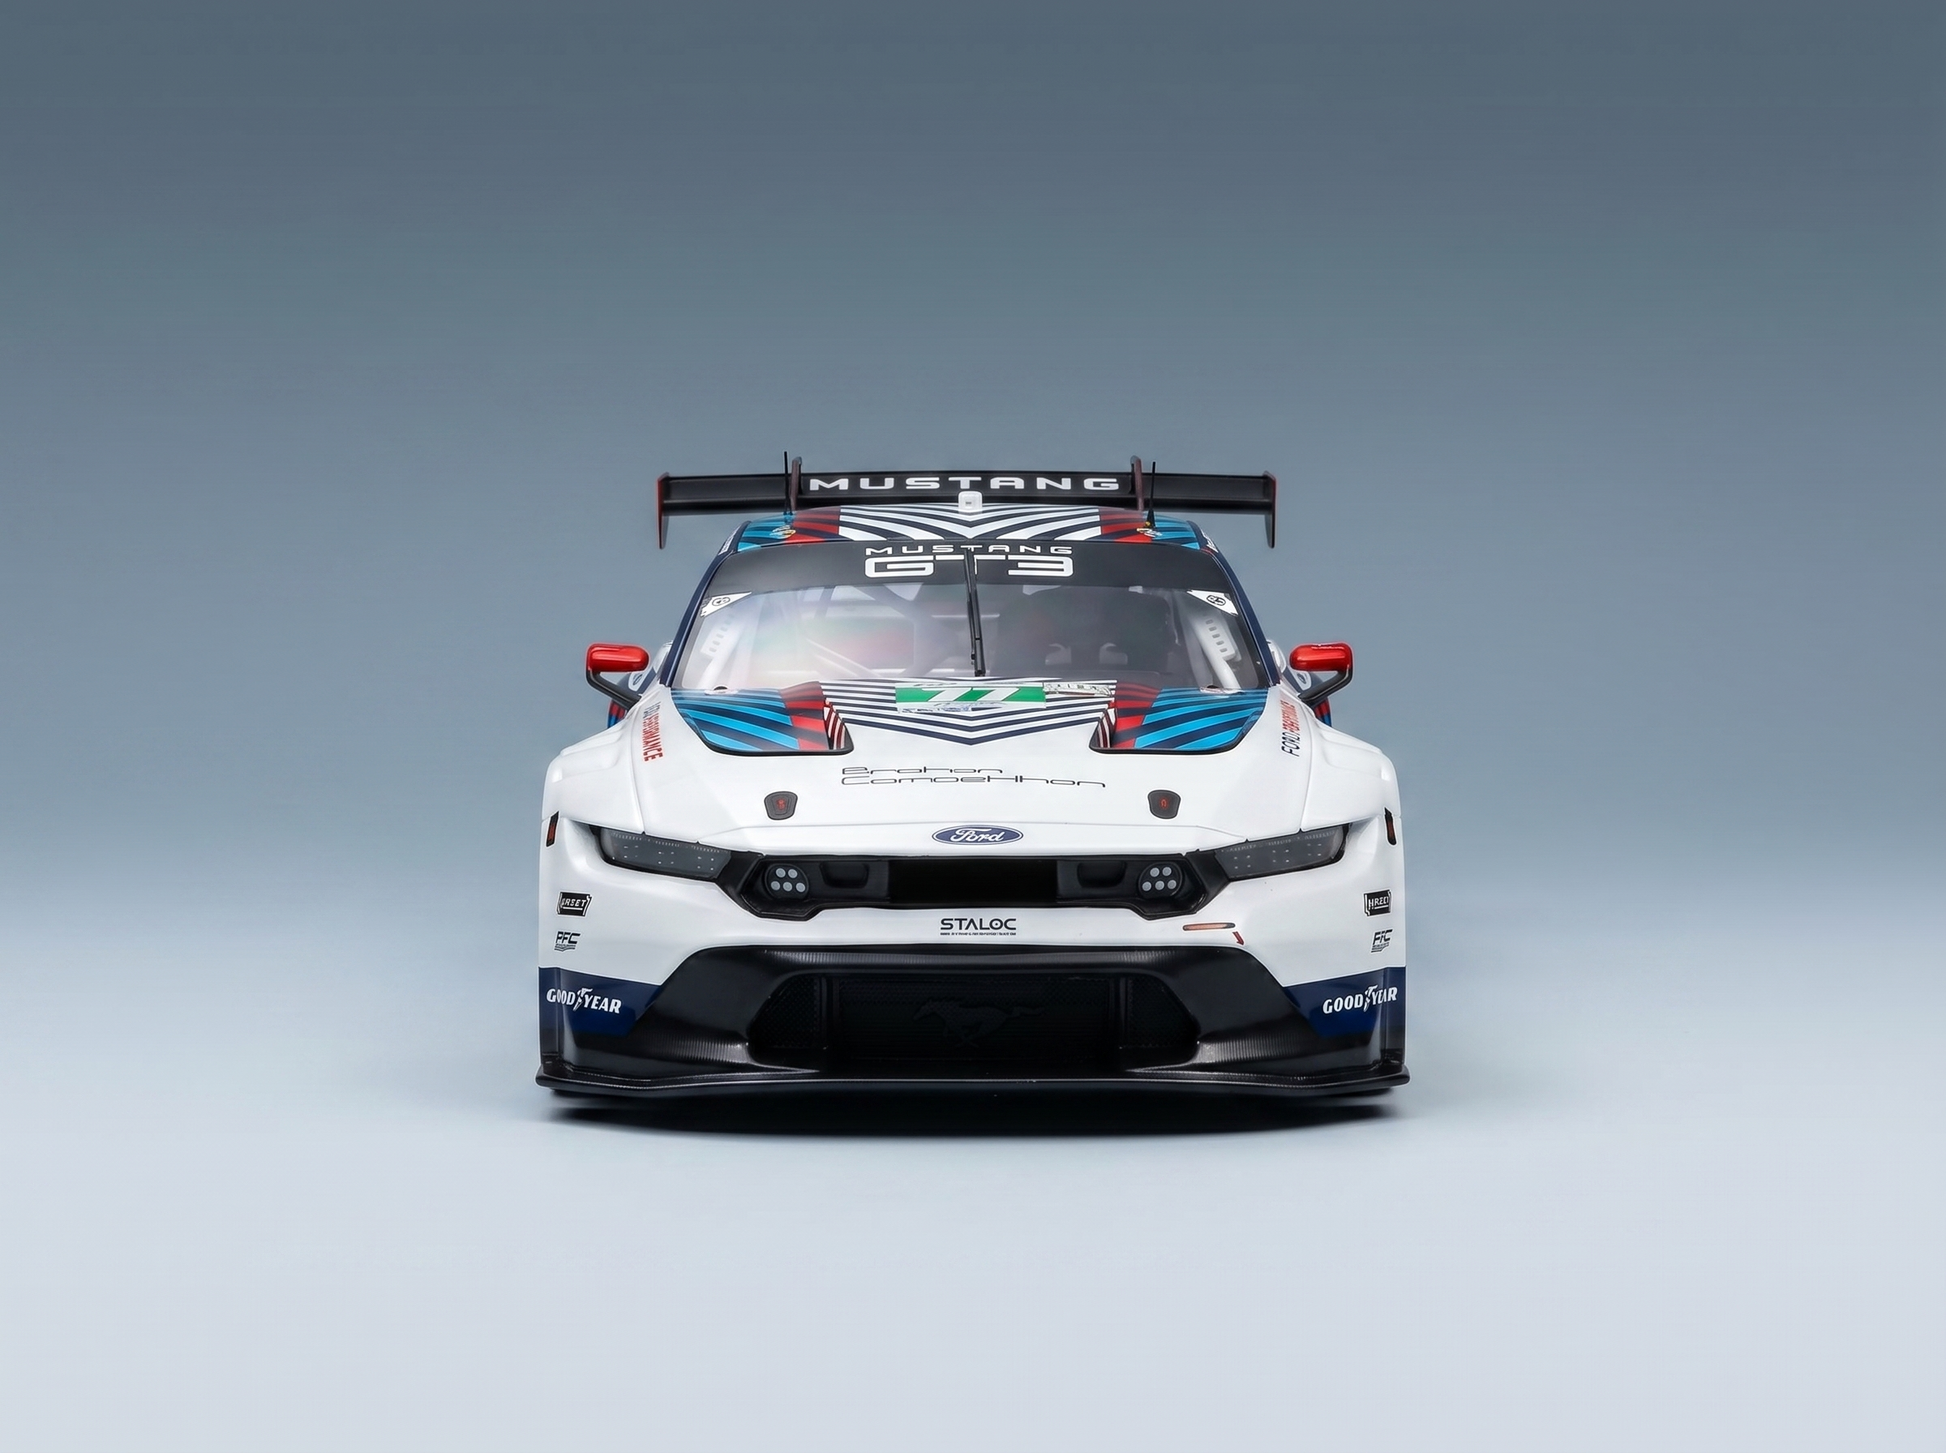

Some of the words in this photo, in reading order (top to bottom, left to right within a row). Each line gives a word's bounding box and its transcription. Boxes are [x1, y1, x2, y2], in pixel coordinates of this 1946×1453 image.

[809, 476, 1120, 491] MUSTANG
[864, 544, 1073, 555] MUSTANG
[864, 554, 1075, 578] GT3
[949, 827, 1006, 842] Ford
[940, 918, 1017, 931] STALOC
